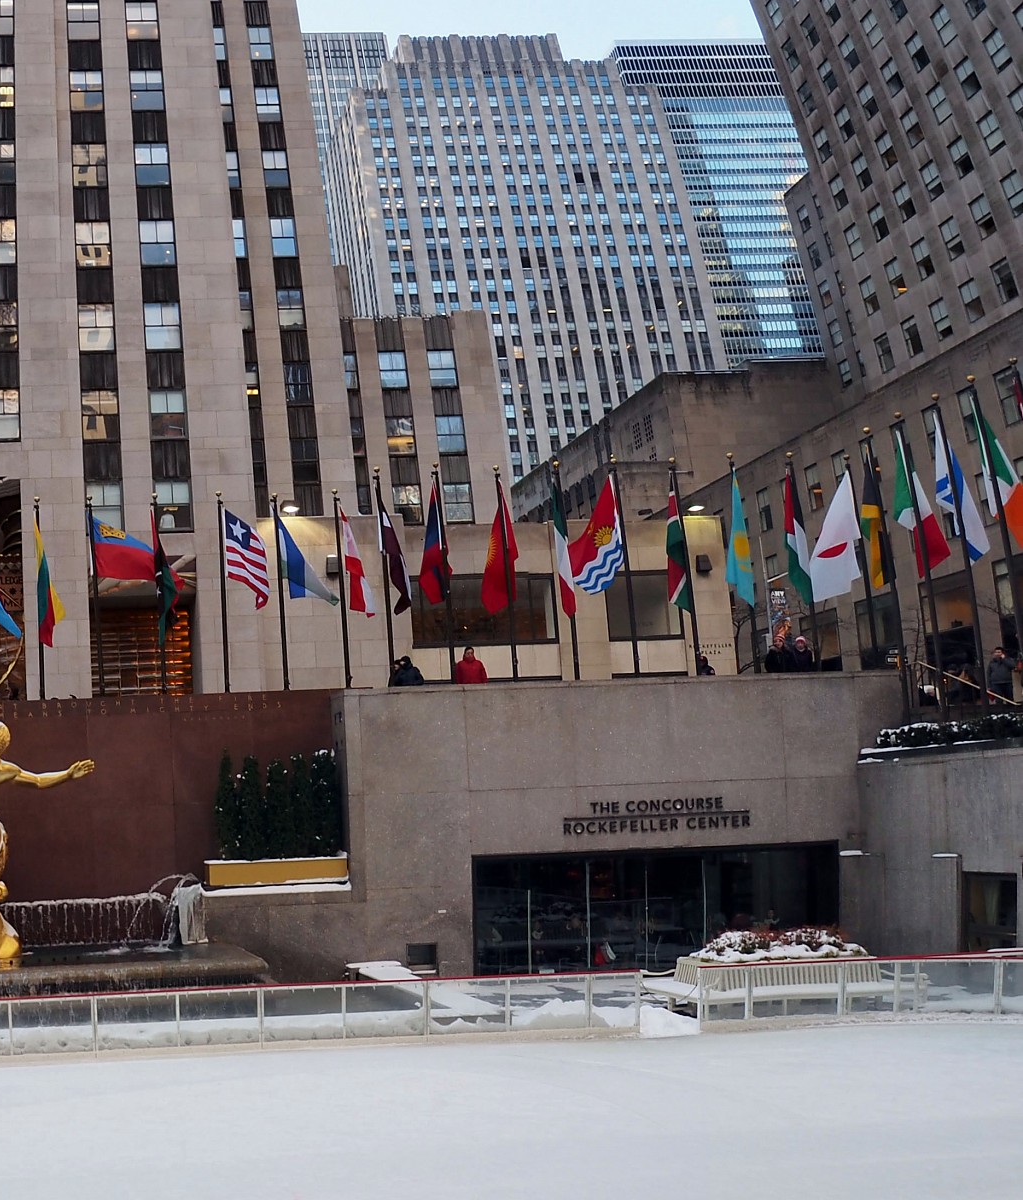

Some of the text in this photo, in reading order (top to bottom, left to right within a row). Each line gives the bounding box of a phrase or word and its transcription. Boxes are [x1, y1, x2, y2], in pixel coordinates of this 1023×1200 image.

[159, 696, 193, 705] THE
[590, 797, 723, 814] THE CONCOURSE
[563, 815, 750, 835] ROCKEFELLER CENTER
